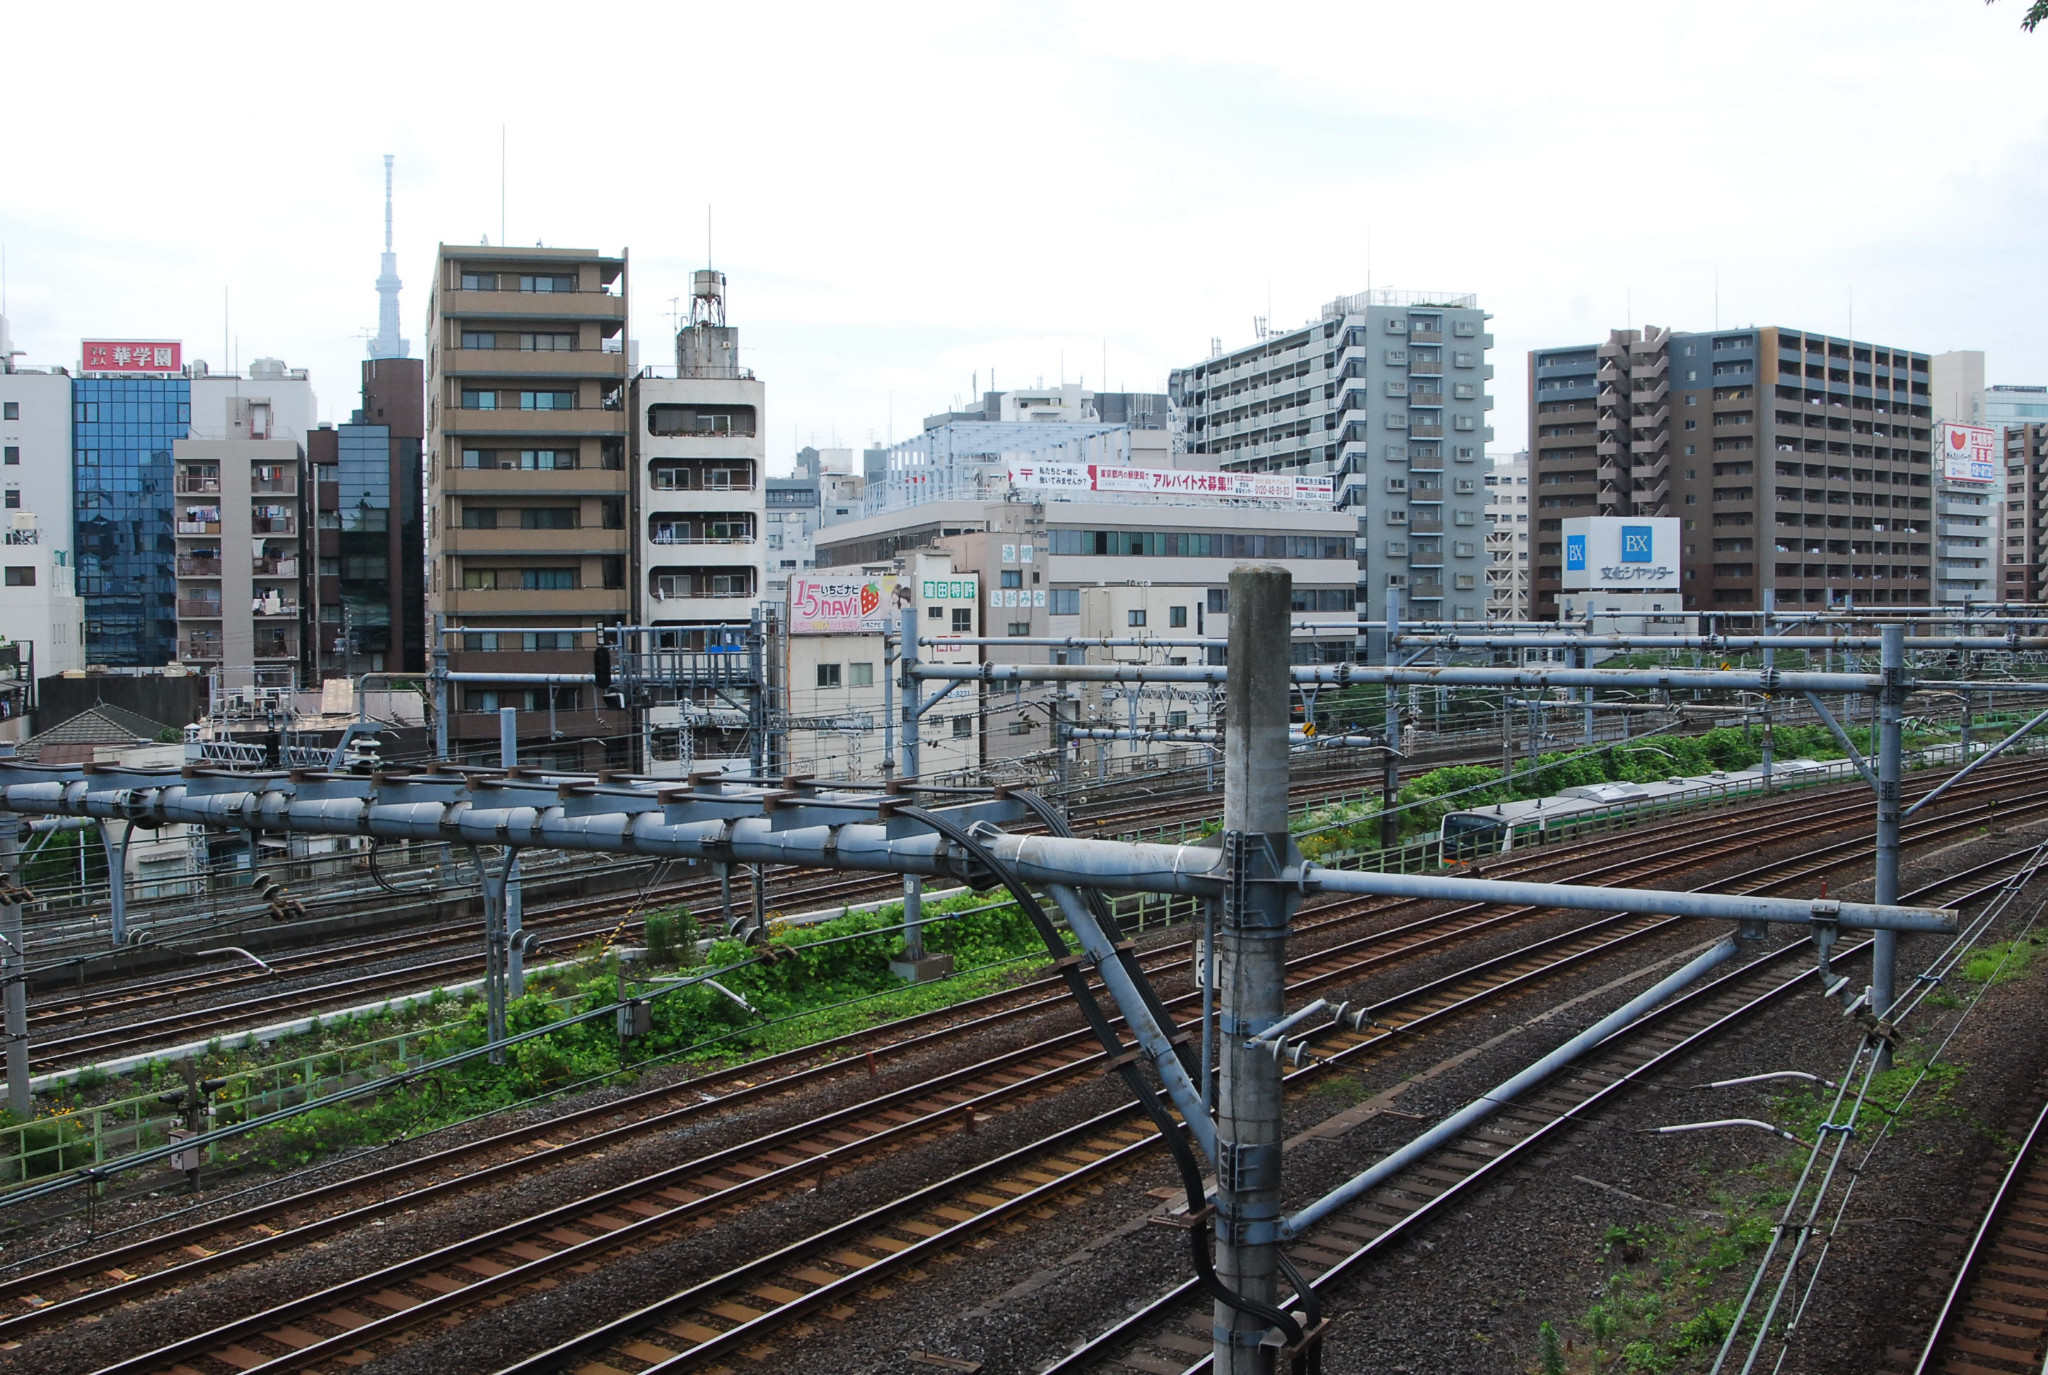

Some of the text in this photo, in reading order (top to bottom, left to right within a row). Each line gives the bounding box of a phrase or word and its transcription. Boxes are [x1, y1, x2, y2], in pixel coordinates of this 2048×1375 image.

[112, 346, 172, 367] 華学園
[1039, 466, 1079, 476] 私たちと一緒に
[1100, 469, 1149, 480] 東京都内の郵便局で
[1626, 535, 1648, 552] BX
[1569, 544, 1583, 561] BX
[793, 580, 821, 617] 15
[820, 585, 860, 595] いちごナビ
